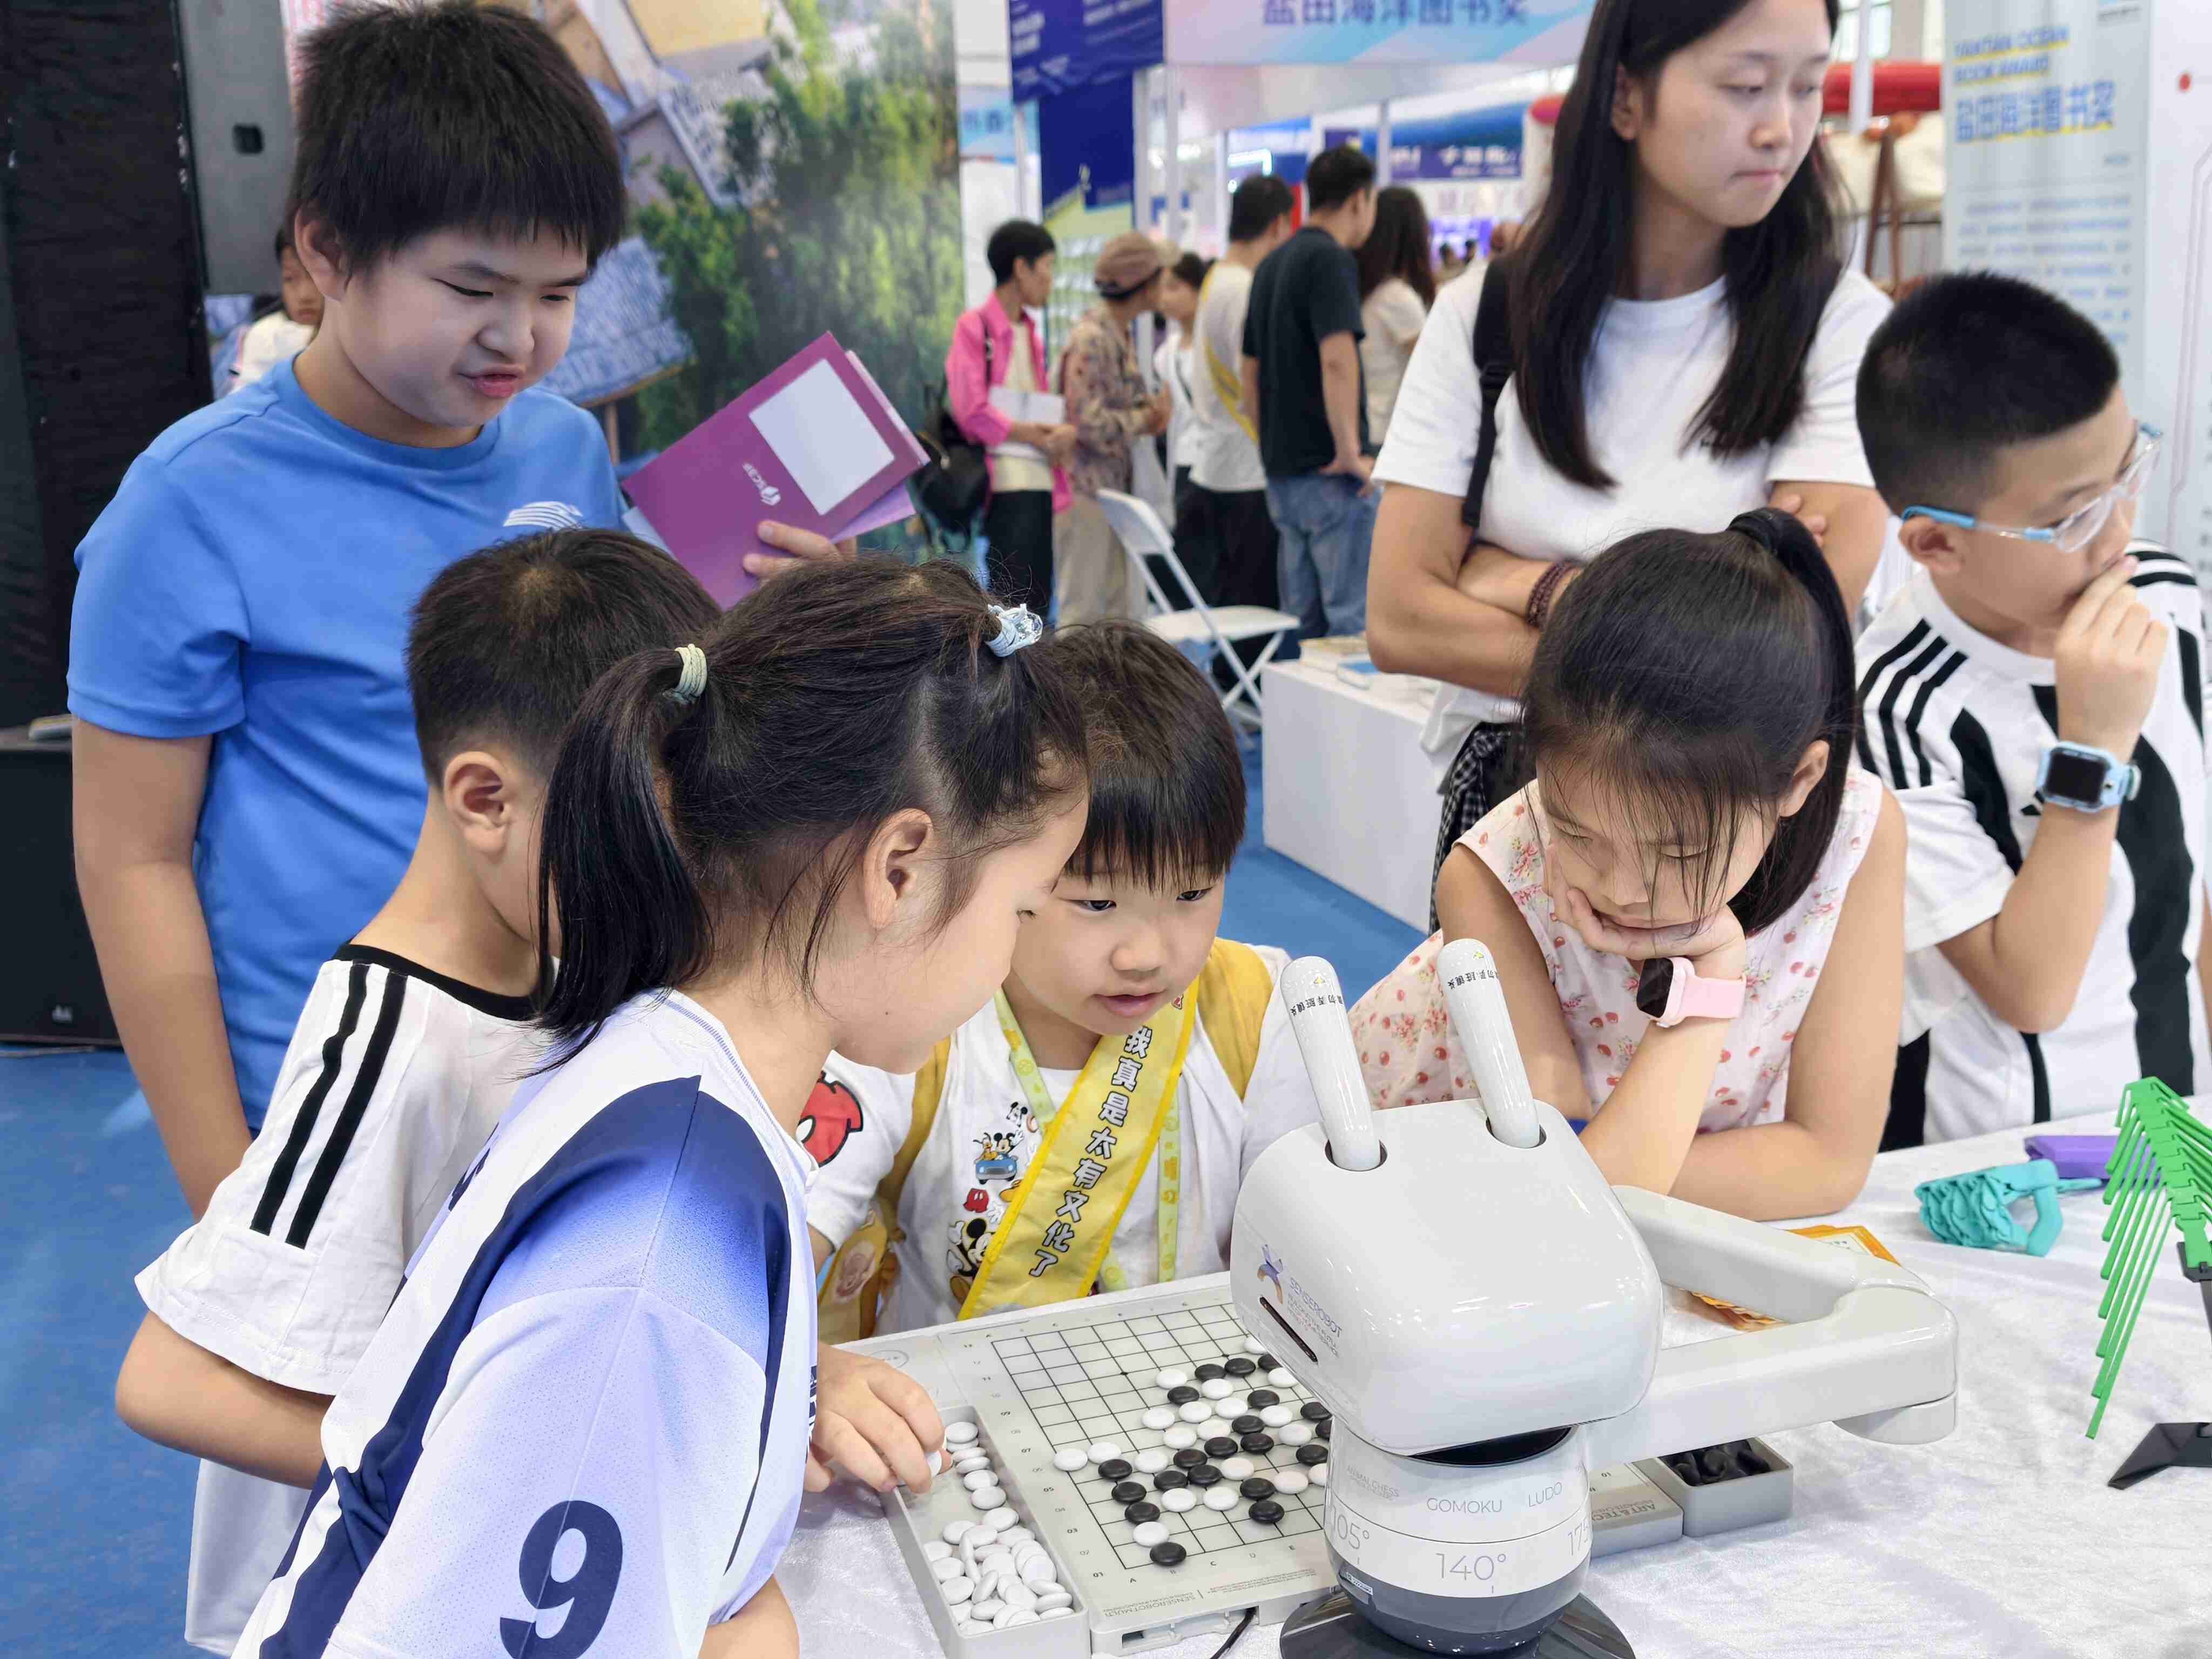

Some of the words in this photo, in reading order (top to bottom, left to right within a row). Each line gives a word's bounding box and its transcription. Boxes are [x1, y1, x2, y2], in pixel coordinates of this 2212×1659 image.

[1028, 1025, 1152, 1278] 我真是太有文化了
[1426, 1497, 1503, 1514] GOMOKU
[1527, 1482, 1563, 1507] LUDO
[500, 1500, 623, 1659] 9
[1435, 1553, 1507, 1581] 140°
